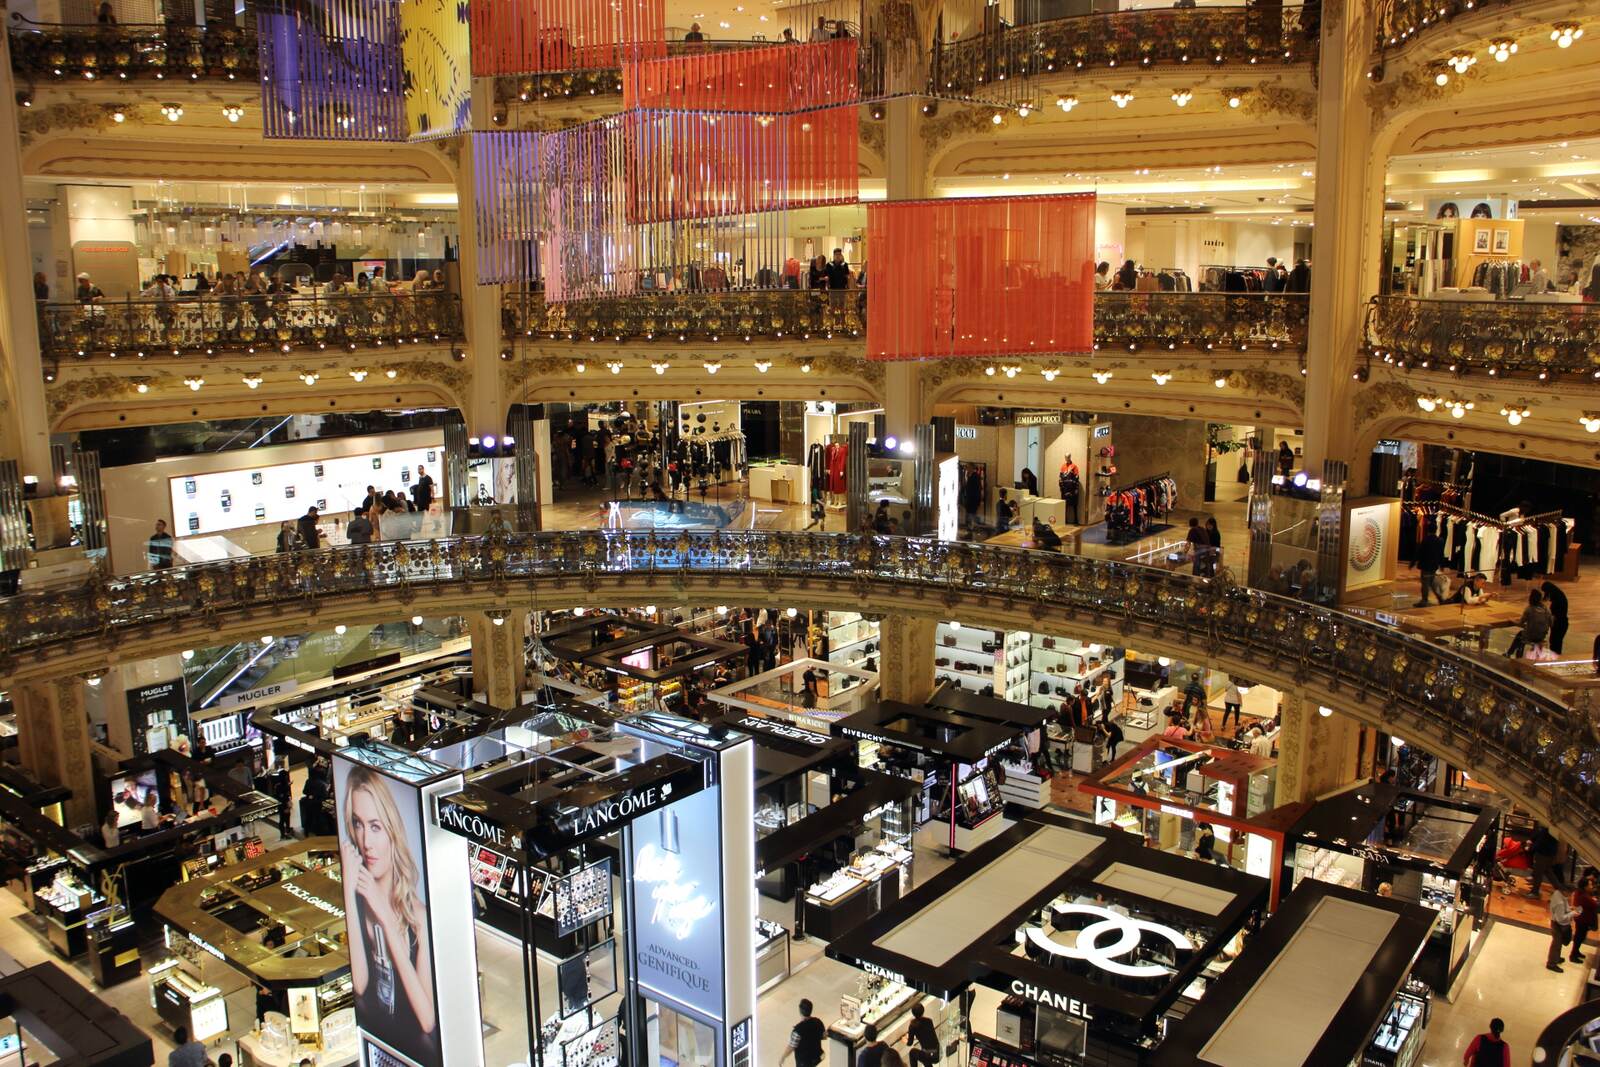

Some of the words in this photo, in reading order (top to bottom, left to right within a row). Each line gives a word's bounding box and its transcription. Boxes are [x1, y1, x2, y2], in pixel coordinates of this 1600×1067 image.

[1017, 415, 1041, 424] EMILIO
[1042, 415, 1061, 423] PUCCI
[140, 685, 173, 697] MUGLER
[238, 685, 281, 702] MUGLER
[842, 727, 883, 743] GIVENCHY
[573, 787, 656, 836] LANCÔME
[1351, 848, 1389, 864] PRADA
[864, 962, 907, 986] CHANEL
[1011, 980, 1094, 1020] CHANEL
